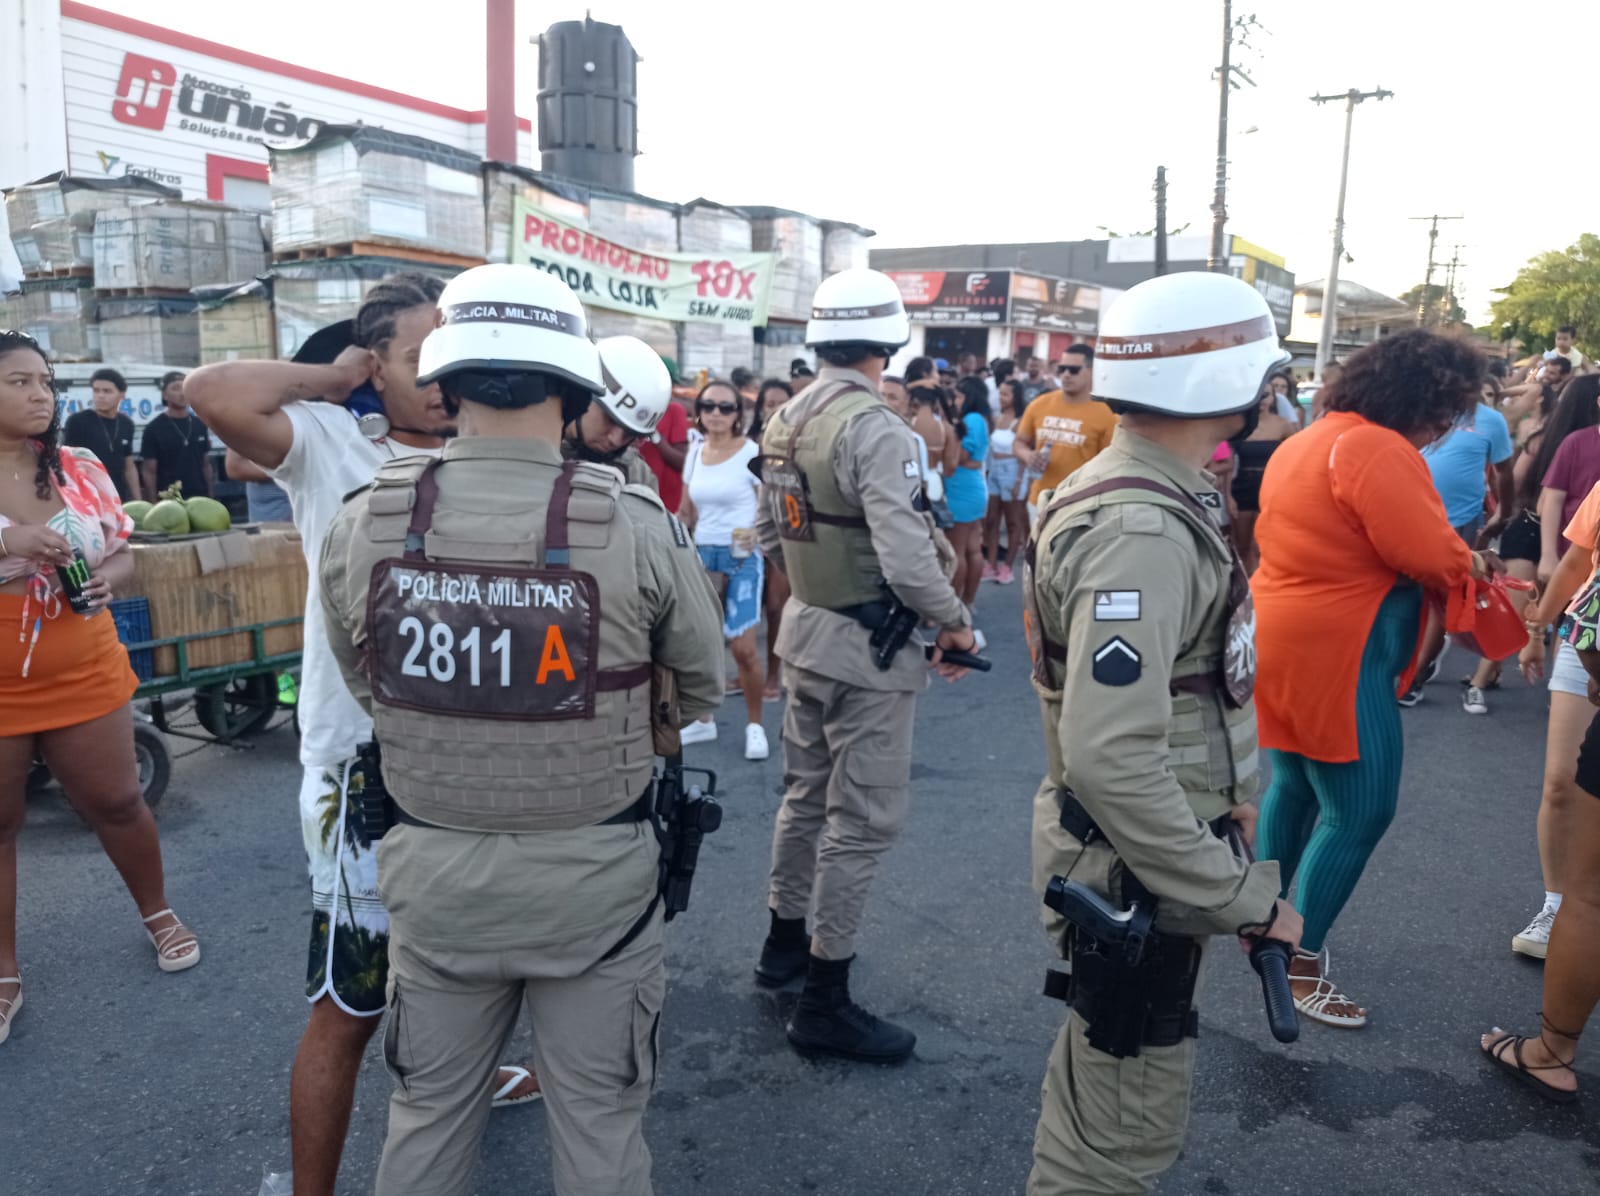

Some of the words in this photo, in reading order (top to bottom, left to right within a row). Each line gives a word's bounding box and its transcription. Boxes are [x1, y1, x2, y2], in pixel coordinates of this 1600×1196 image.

[180, 119, 243, 140] Soluções
[608, 277, 658, 310] LOJA
[688, 301, 720, 317] SEM
[505, 307, 558, 325] MILITAR
[1105, 342, 1153, 354] MILITAR
[398, 572, 482, 605] POLÍCIA
[488, 581, 574, 608] MILITAR
[398, 616, 511, 687] 2811
[535, 624, 576, 686] A
